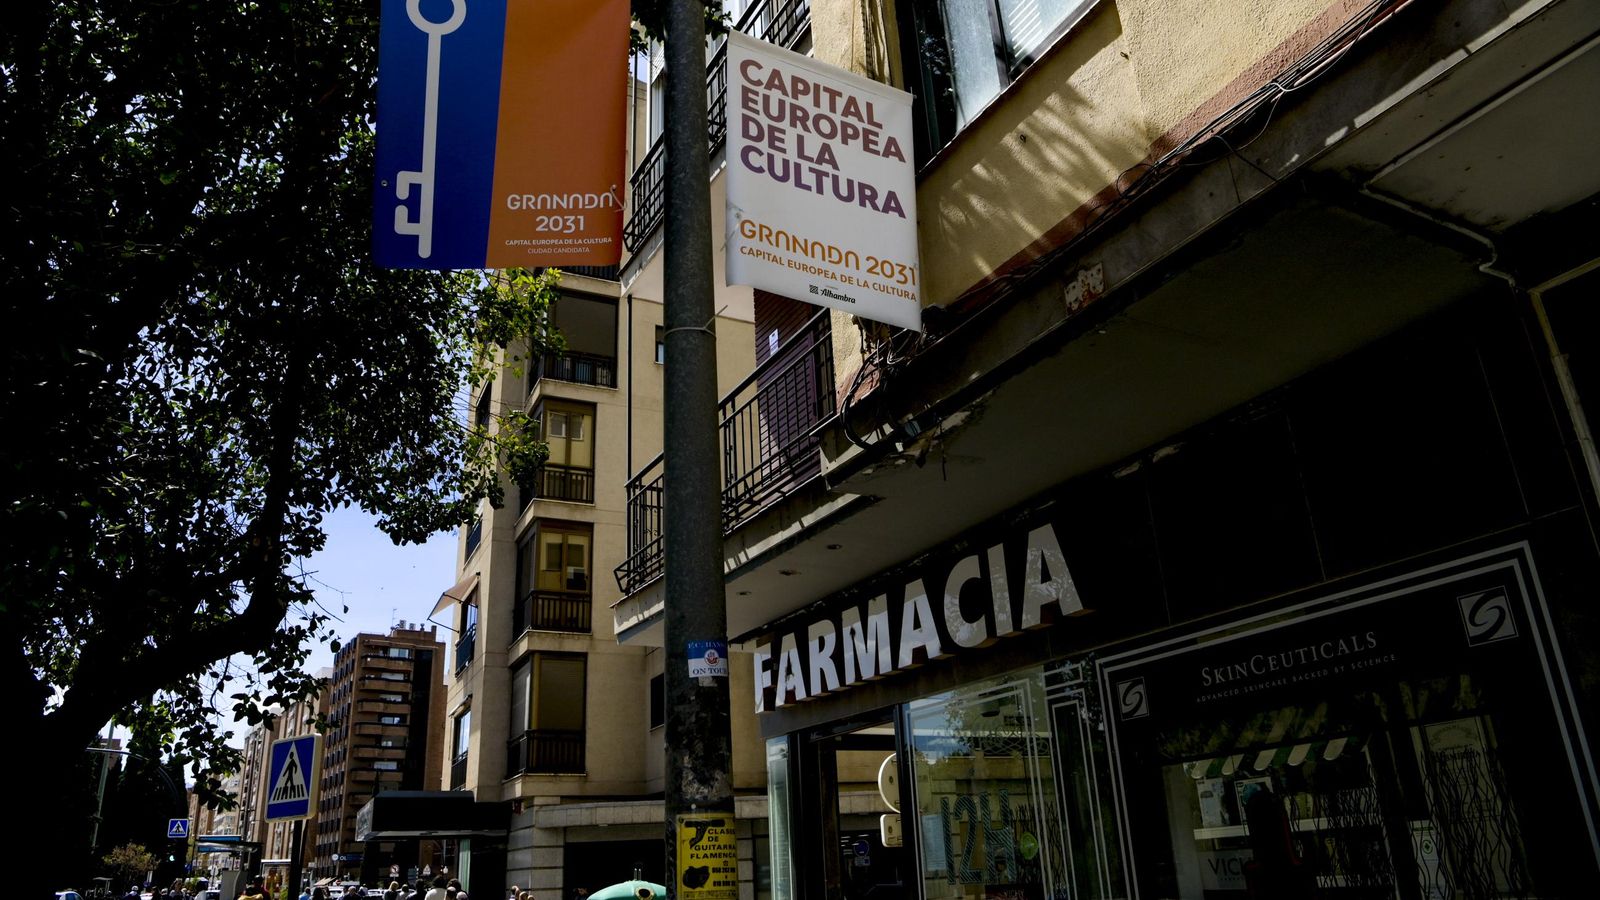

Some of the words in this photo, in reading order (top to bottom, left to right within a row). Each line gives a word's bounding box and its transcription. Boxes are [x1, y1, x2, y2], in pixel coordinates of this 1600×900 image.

[740, 59, 882, 129] CAPITAL
[742, 84, 906, 163] EUROPEA
[742, 113, 787, 154] DE
[797, 134, 840, 172] LA
[506, 192, 612, 210] GRANADA
[740, 145, 906, 219] CULTURA
[536, 215, 584, 234] 2031
[553, 246, 590, 254] CANDIDATA
[740, 219, 860, 270] GRANADA
[866, 256, 917, 286] 2031
[740, 246, 785, 266] CAPITAL
[788, 259, 838, 281] EUROPEA
[840, 274, 854, 286] DE
[857, 278, 870, 289] LA
[872, 282, 917, 302] CULTURA
[820, 288, 856, 304] Alhambra
[754, 522, 1084, 714] FARMACIA
[1196, 688, 1240, 703] ADVANCED
[1244, 677, 1288, 694] SKINCARE
[1292, 668, 1329, 682] BACKED
[1334, 665, 1346, 674] BY
[1351, 654, 1397, 670] SCIENCE
